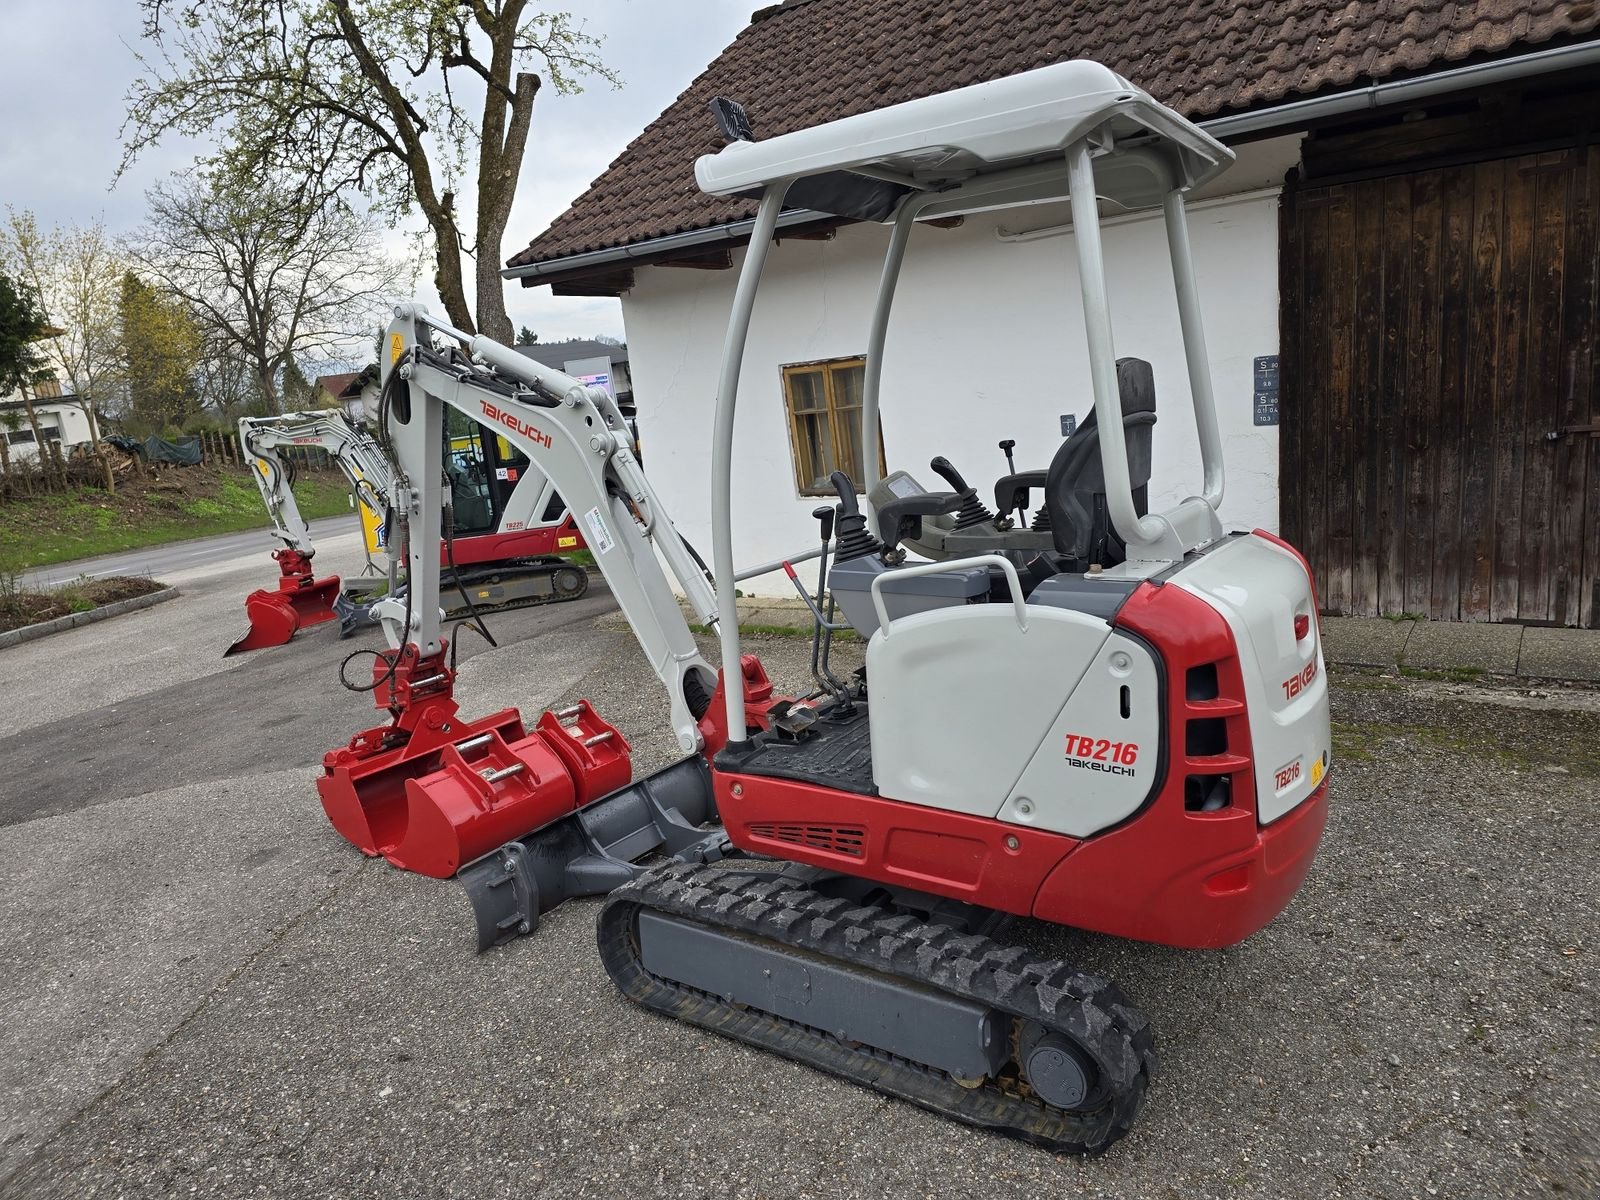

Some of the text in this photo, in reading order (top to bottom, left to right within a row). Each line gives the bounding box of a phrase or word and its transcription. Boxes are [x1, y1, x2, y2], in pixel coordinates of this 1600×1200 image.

[1260, 361, 1267, 369] S
[1260, 396, 1266, 404] S
[479, 400, 552, 449] TAKEUCHI
[505, 521, 524, 529] TB225
[1065, 734, 1139, 765] TB216
[1065, 757, 1135, 777] TAKEUCHI
[1275, 762, 1300, 790] TB216
